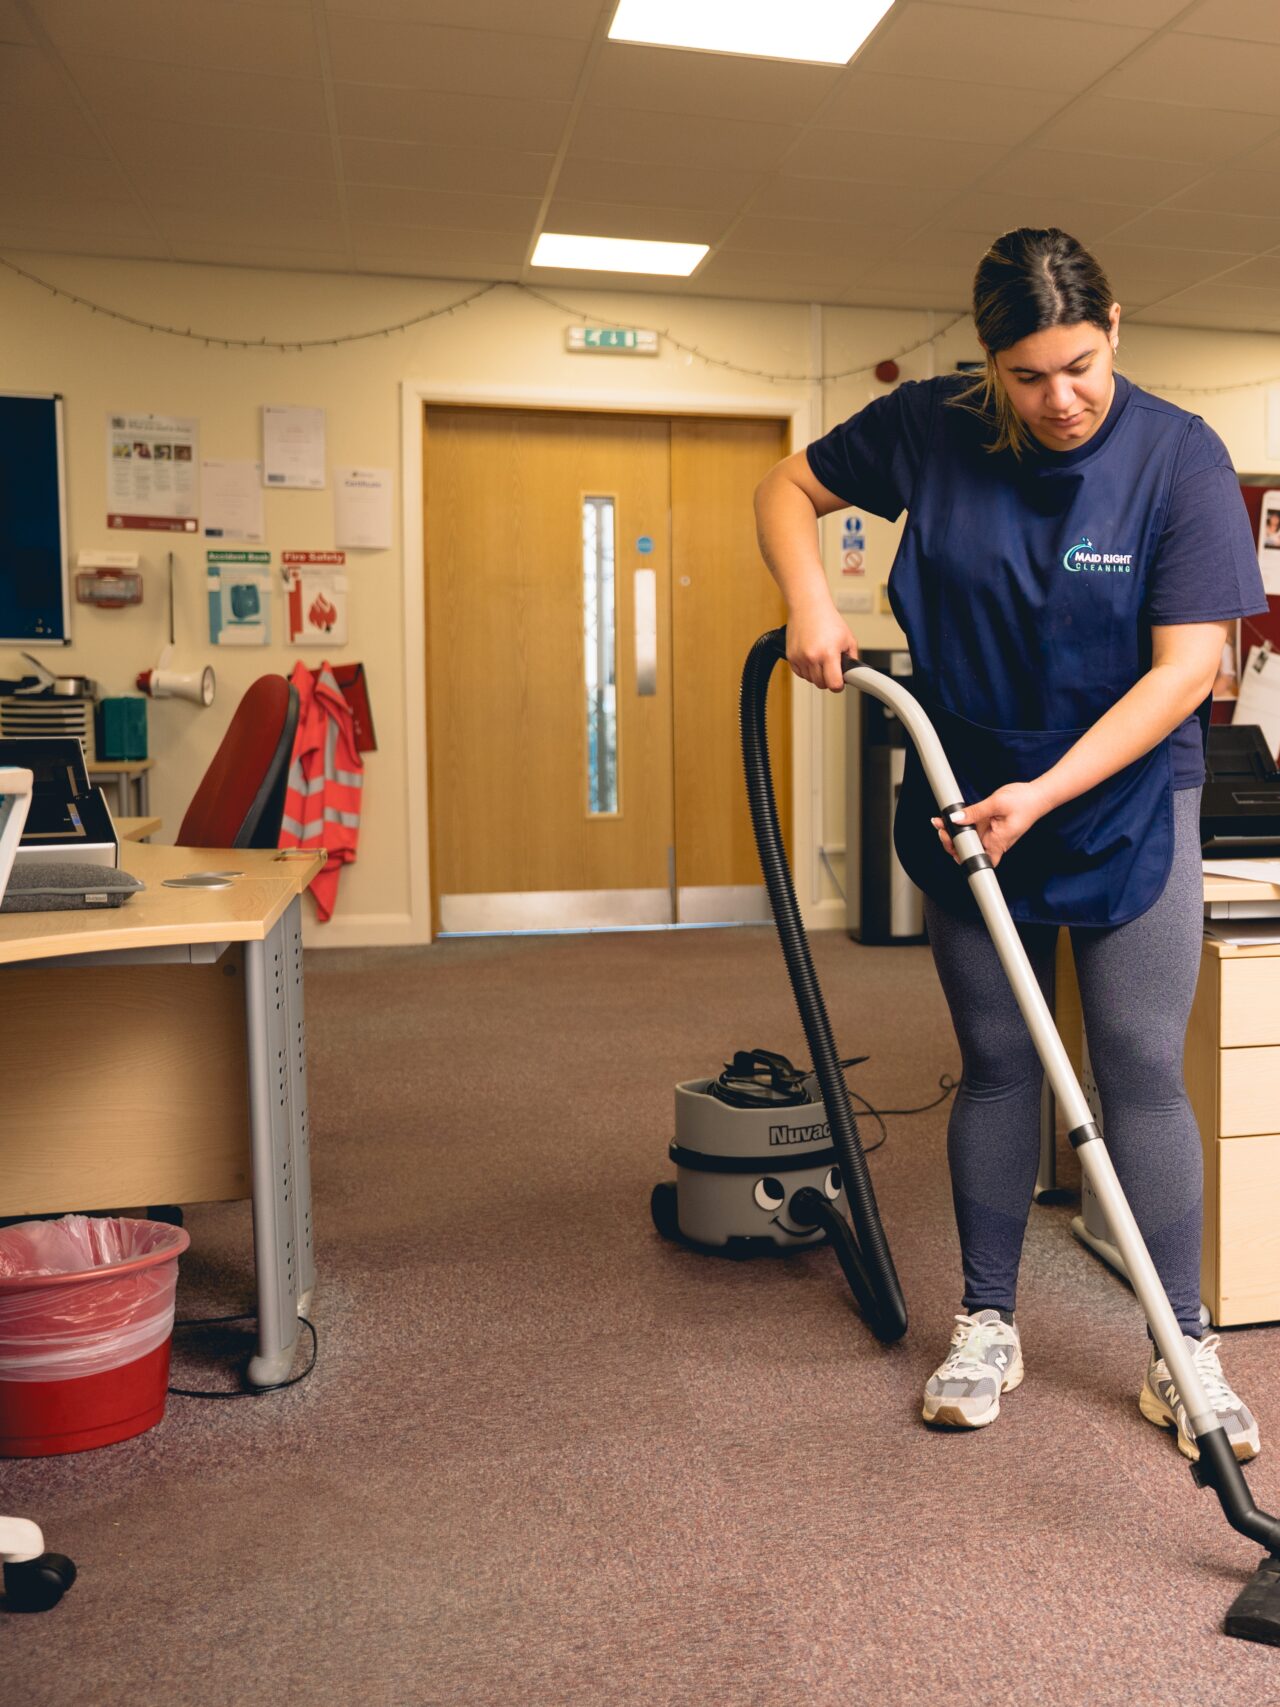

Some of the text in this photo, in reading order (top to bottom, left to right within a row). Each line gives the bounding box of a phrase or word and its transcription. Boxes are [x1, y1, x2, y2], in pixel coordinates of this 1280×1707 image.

[208, 552, 246, 561] Accident
[284, 552, 344, 564] Fire Safety
[1075, 552, 1132, 564] MAID RIGHT
[1076, 563, 1131, 573] CLEANING
